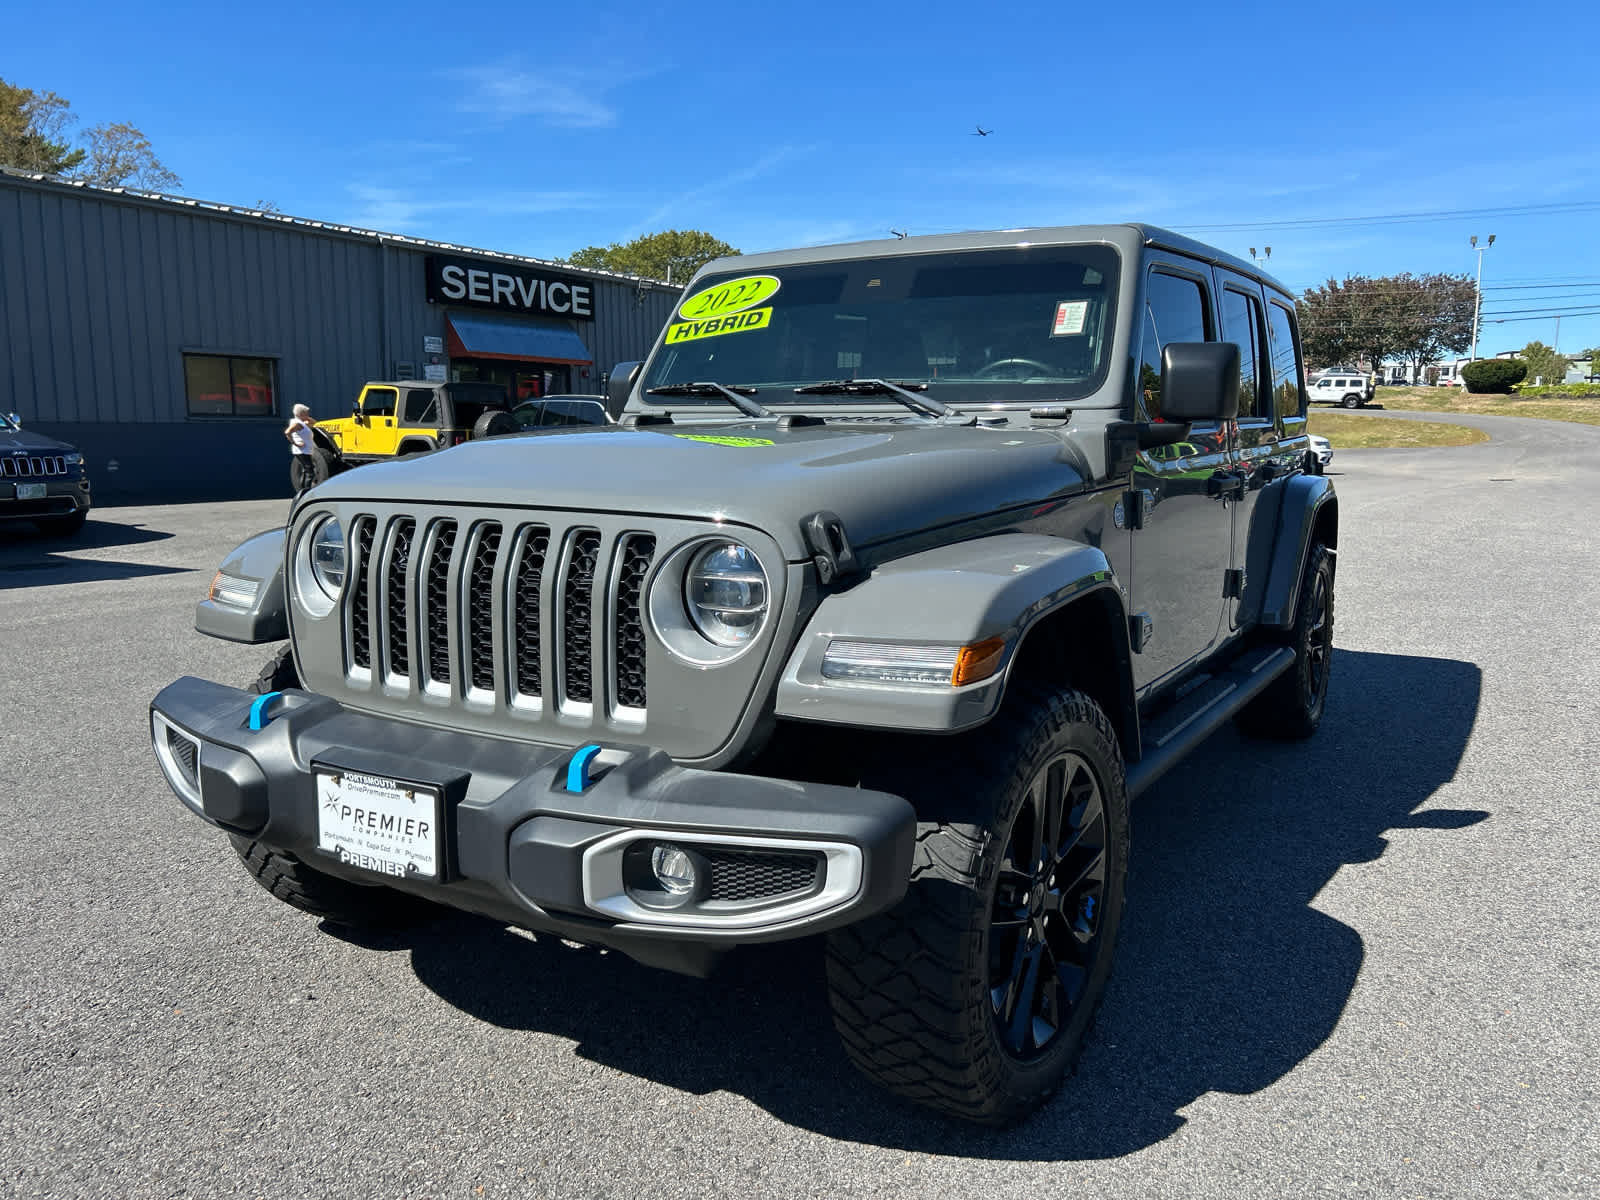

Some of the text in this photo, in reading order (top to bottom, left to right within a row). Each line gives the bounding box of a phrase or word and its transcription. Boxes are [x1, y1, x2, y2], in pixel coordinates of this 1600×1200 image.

[441, 265, 591, 315] SERVICE
[693, 280, 762, 315] 2022
[674, 312, 764, 340] HYBRID
[343, 772, 397, 789] PORTSMOUTH
[341, 805, 429, 840] PREMIER
[352, 825, 413, 844] COMPANIES
[340, 850, 406, 878] PREMIER
